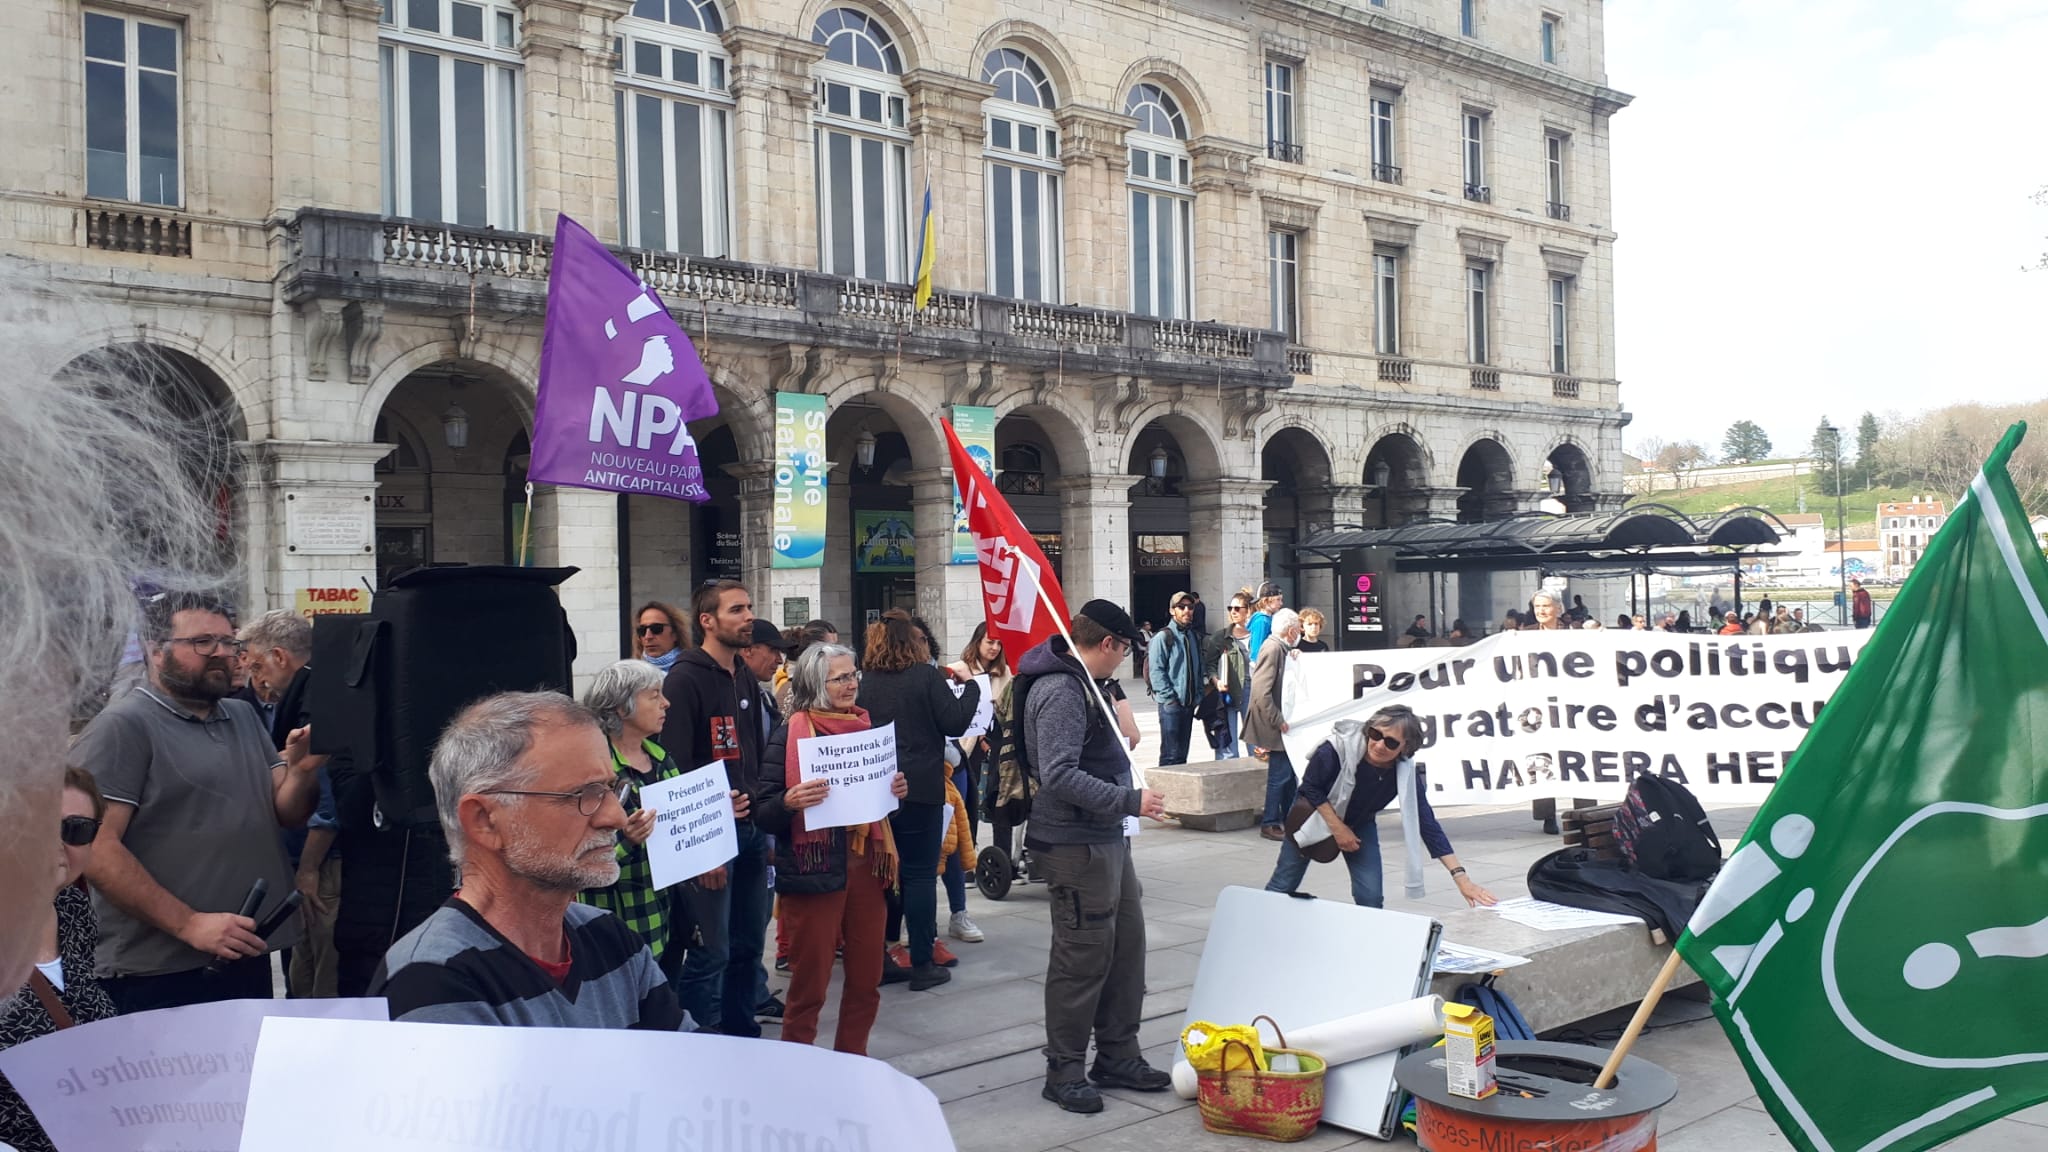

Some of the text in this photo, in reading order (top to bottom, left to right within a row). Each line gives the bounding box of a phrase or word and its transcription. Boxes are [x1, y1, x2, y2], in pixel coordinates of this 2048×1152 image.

[588, 386, 699, 457] NPA
[590, 451, 702, 480] NOUVEAU PART
[803, 410, 826, 507] Scène
[774, 407, 800, 551] nationale
[375, 495, 405, 508] UX
[306, 588, 359, 602] TABAC
[1353, 642, 1853, 700] Pour une politiqu
[1419, 694, 1828, 749] gratoire d'accu
[817, 739, 881, 757] Migranteak
[810, 760, 860, 774] laguntza
[843, 773, 865, 788] gisa
[1461, 750, 1690, 790] HARRERA
[1706, 750, 1796, 784] HE
[668, 781, 705, 802] Présenter
[657, 802, 704, 823] migrant.es
[670, 809, 723, 836] des profiteurs
